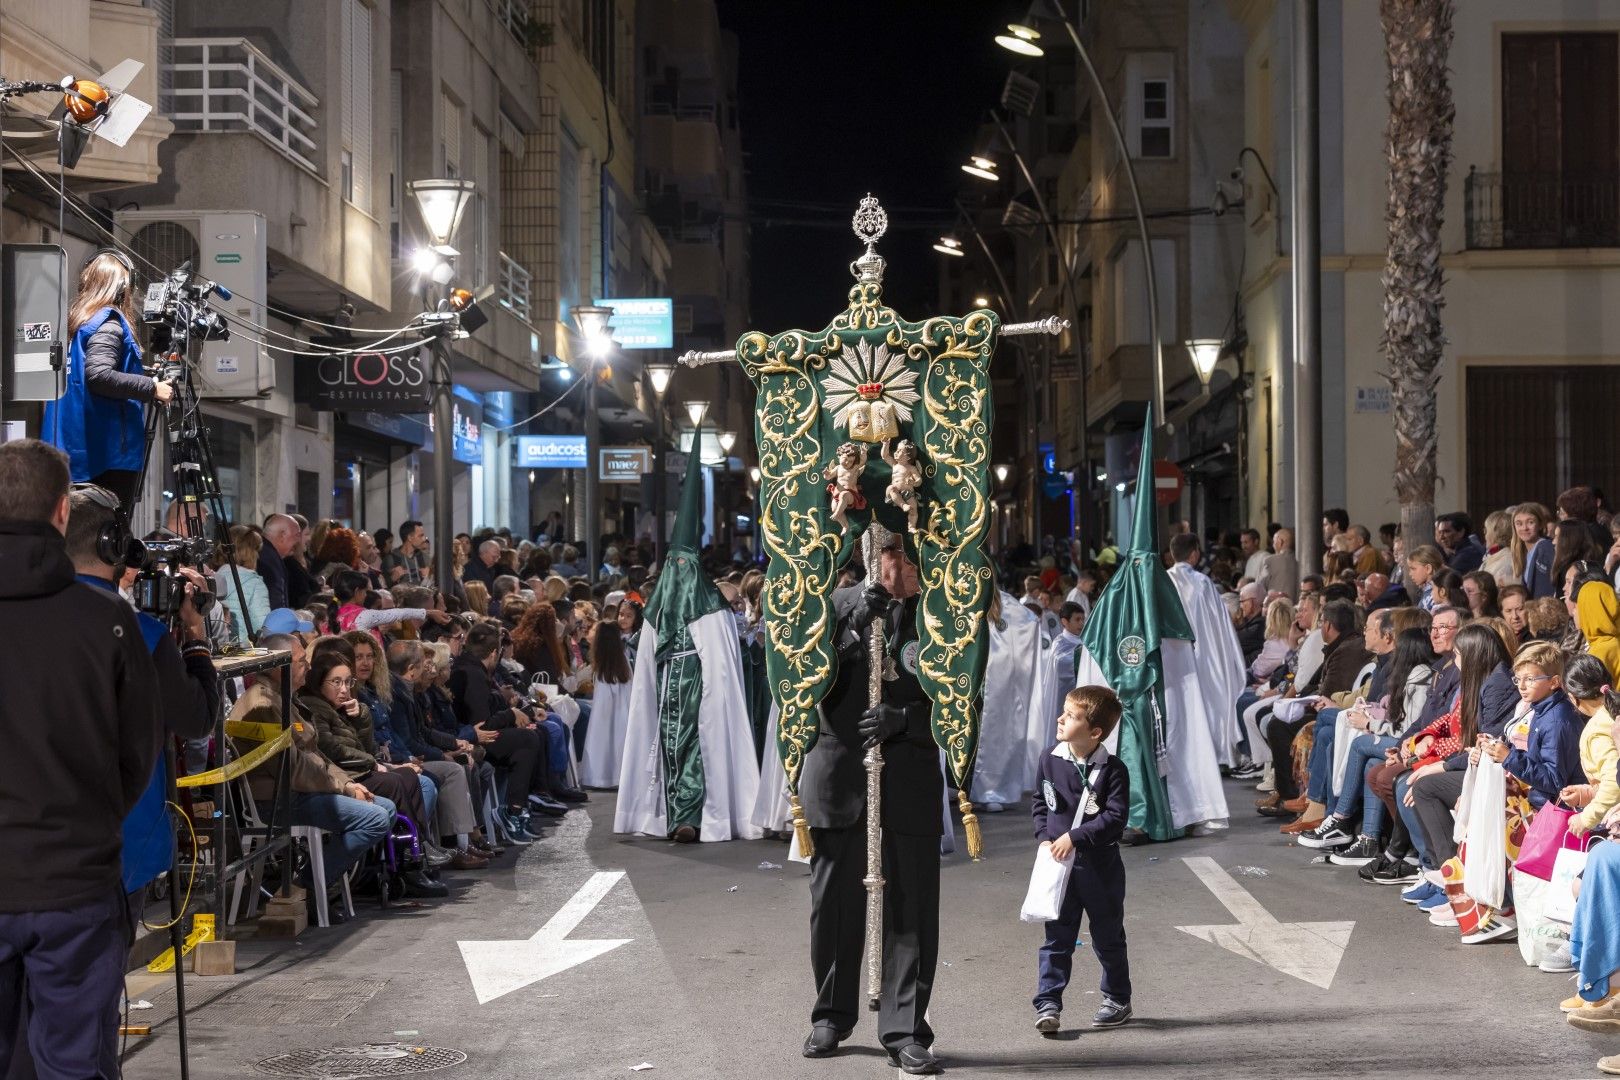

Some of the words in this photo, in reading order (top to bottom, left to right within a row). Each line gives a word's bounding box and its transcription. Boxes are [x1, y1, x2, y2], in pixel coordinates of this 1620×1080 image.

[319, 352, 422, 385] GLOSS
[329, 390, 410, 400] ESTILISTAS
[527, 442, 586, 456] audicost
